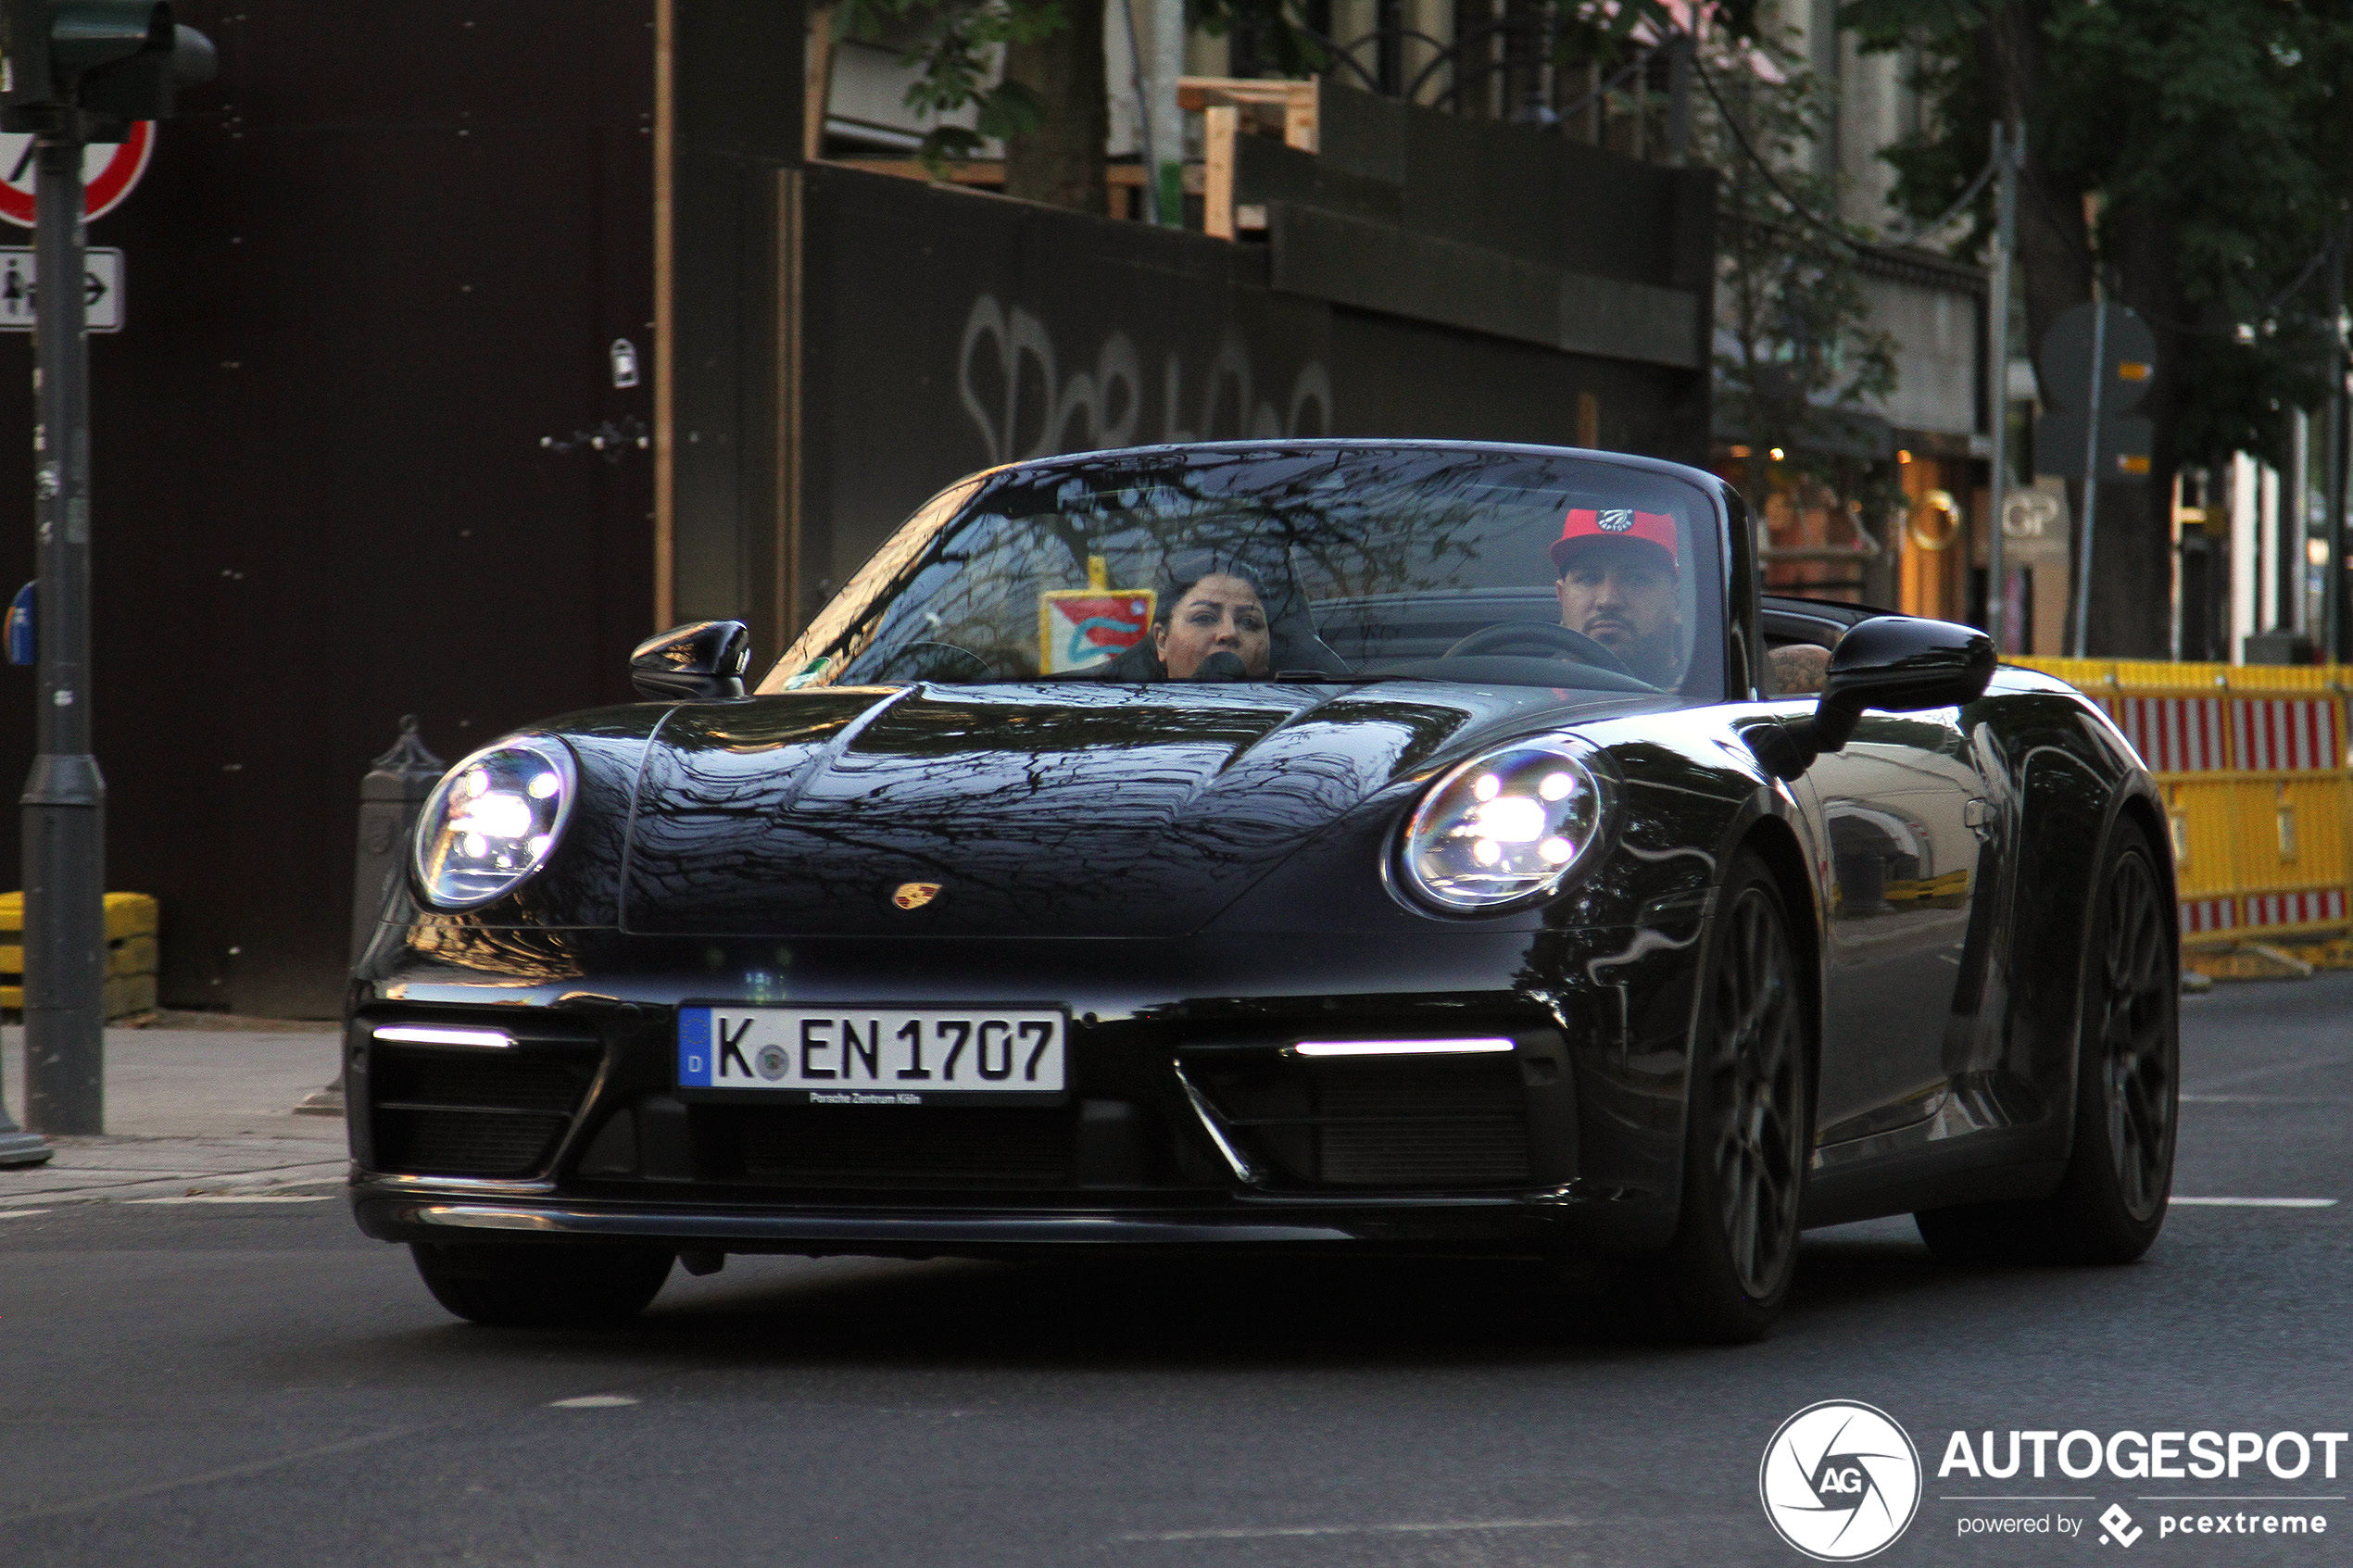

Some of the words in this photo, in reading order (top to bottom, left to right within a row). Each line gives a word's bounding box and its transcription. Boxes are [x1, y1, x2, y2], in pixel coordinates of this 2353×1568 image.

[719, 1017, 754, 1078] K
[688, 1056, 702, 1073] D
[809, 1091, 850, 1104] Porsche
[851, 1092, 895, 1104] Zentrum
[896, 1092, 922, 1105] Köln
